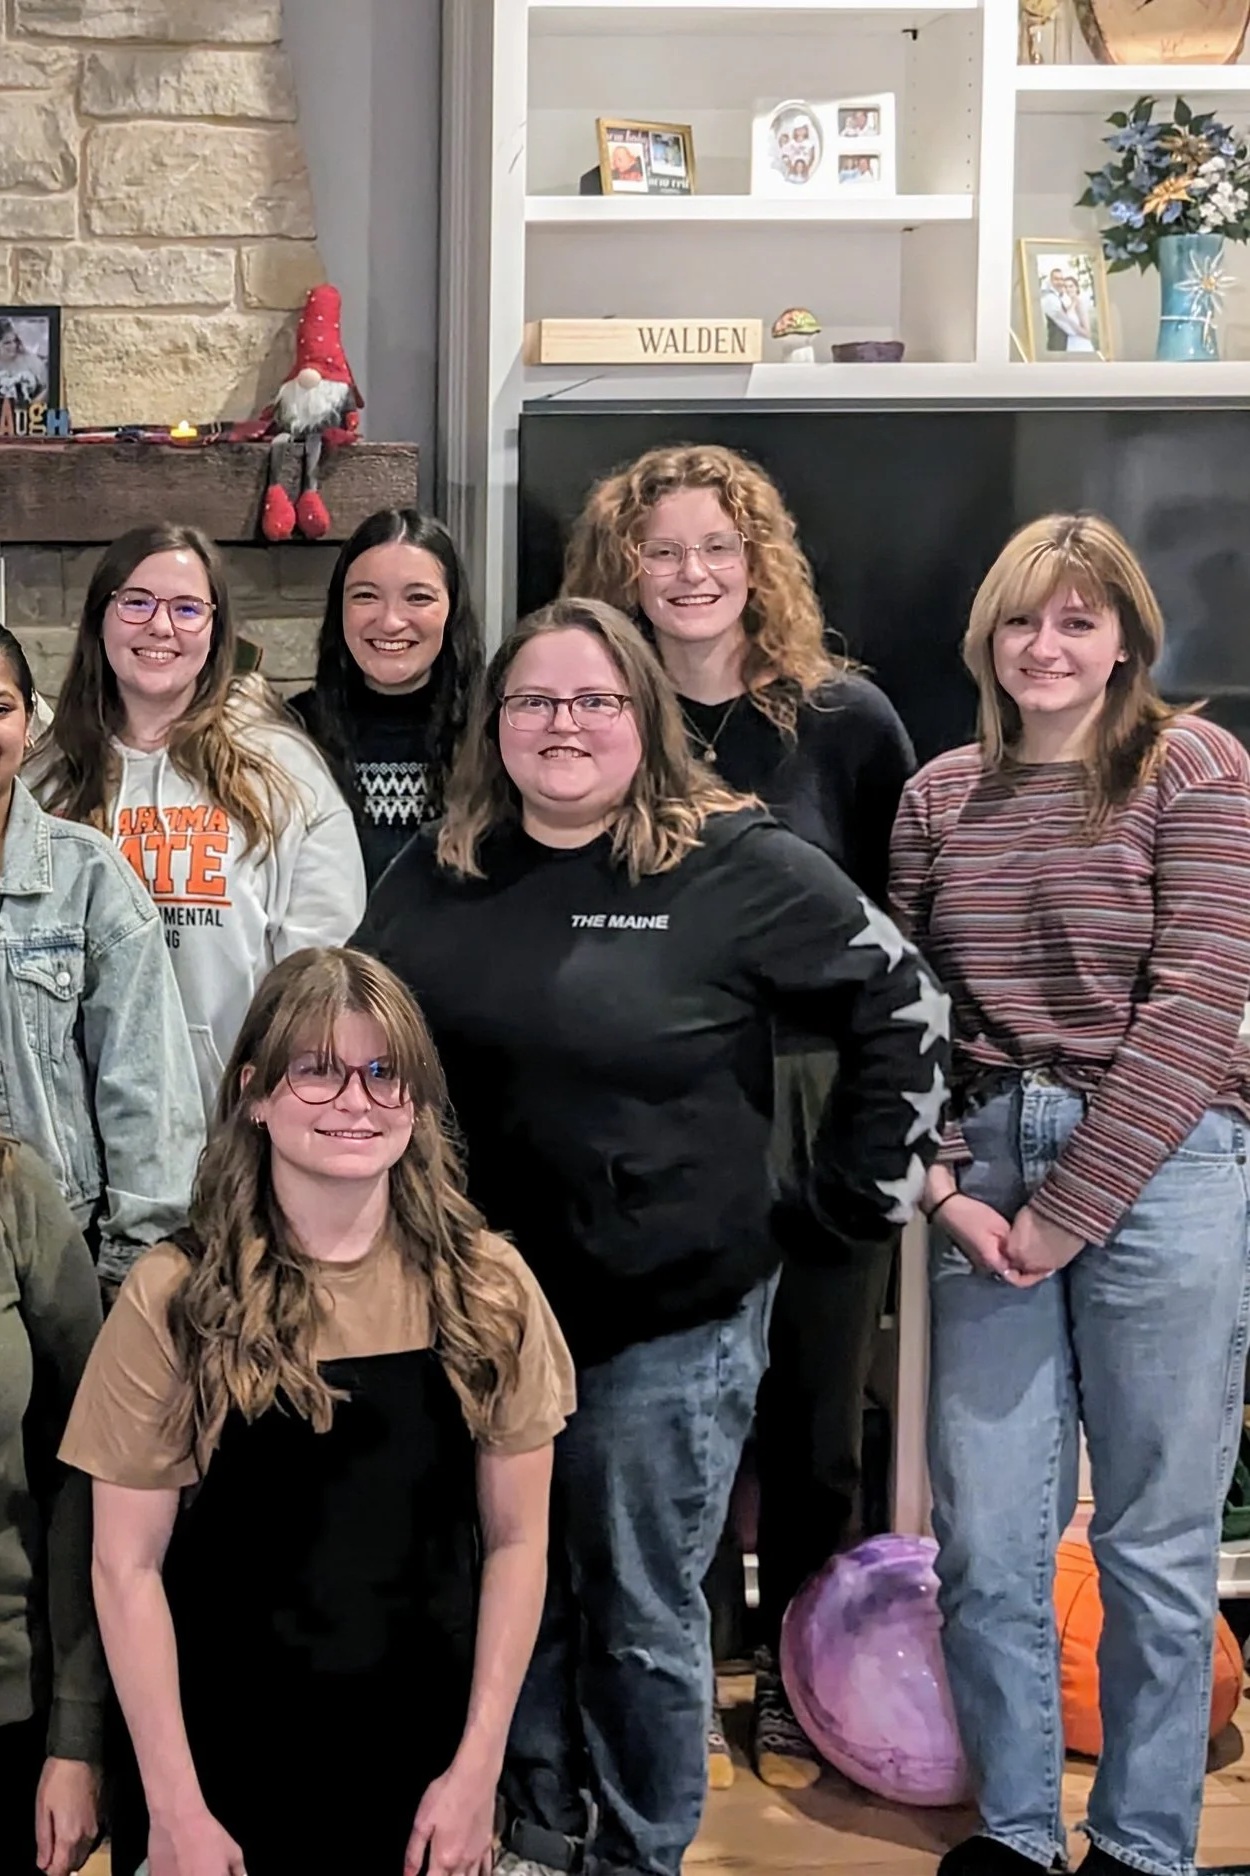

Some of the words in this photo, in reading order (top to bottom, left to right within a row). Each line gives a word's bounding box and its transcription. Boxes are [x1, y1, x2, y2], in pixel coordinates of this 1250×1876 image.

[638, 326, 747, 354] WALDEN
[158, 907, 224, 928] MENTAL
[571, 914, 607, 928] THE
[608, 914, 670, 930] MAINE
